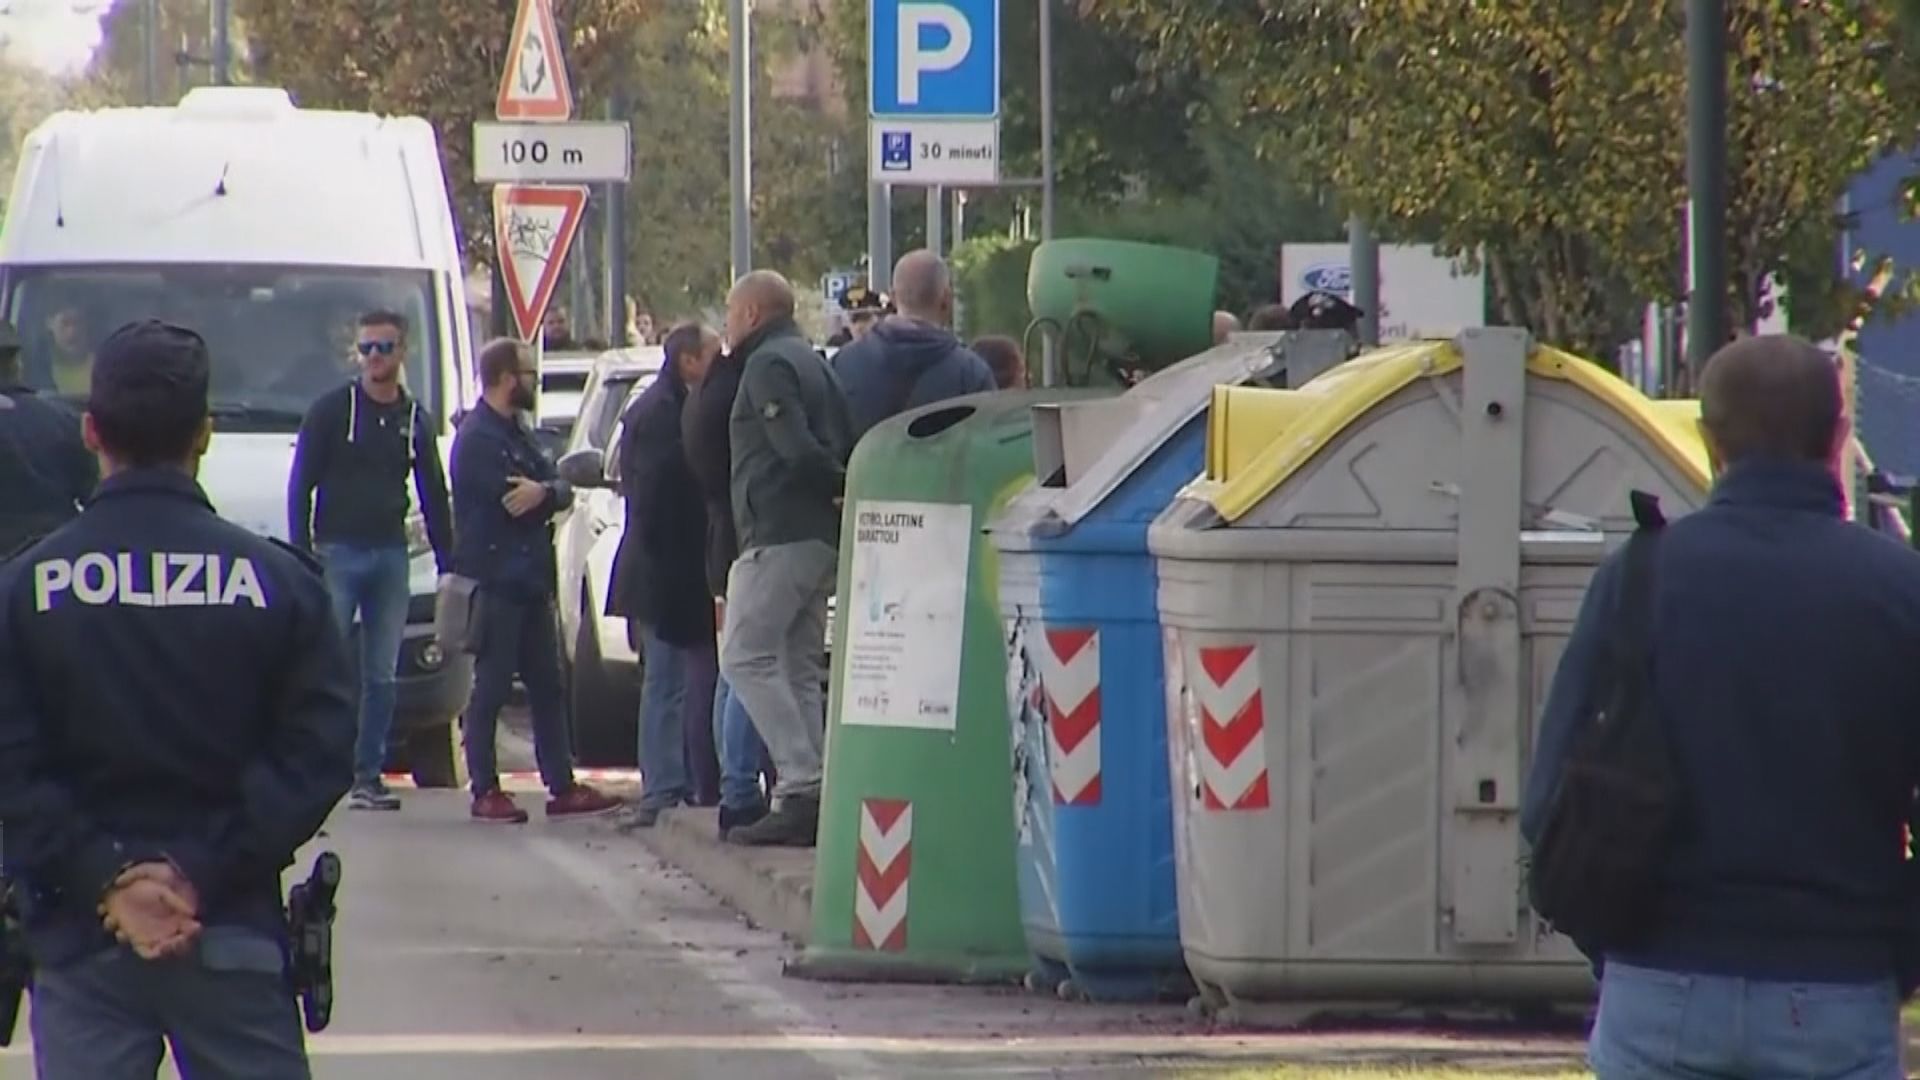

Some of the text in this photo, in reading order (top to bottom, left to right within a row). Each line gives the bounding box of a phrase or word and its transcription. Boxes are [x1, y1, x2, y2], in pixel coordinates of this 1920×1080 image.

[897, 2, 972, 105] P
[502, 140, 583, 164] 100 m
[919, 142, 993, 160] 30 minuti
[827, 278, 845, 298] P
[884, 513, 925, 529] LATTINE
[35, 552, 267, 612] POLIZIA
